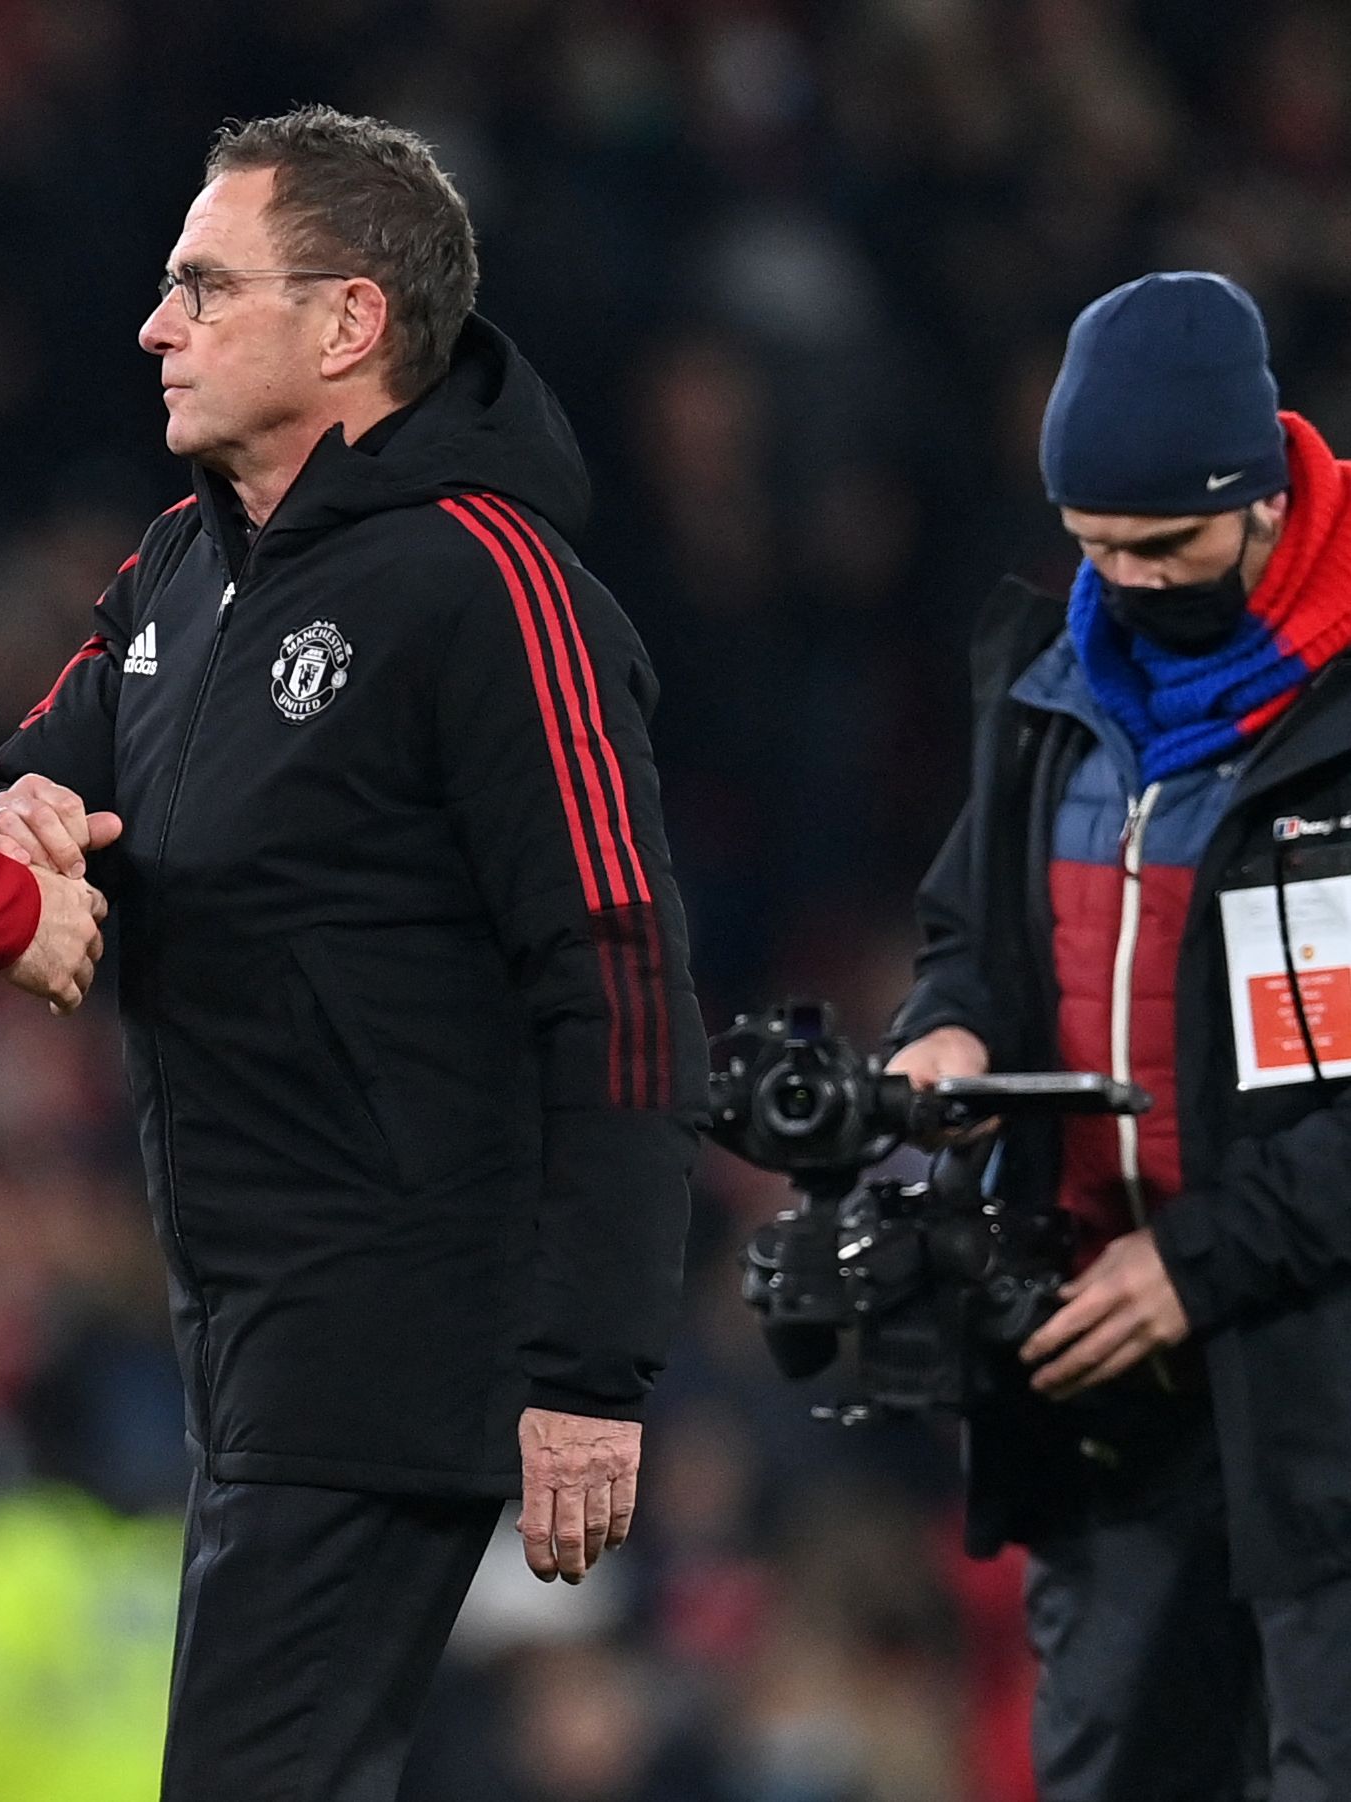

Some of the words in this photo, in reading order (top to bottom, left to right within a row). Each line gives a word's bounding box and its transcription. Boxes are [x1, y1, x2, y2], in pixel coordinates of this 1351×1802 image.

[285, 627, 345, 665] MANCHESTER
[123, 655, 158, 676] adidas
[277, 692, 321, 714] UNITED
